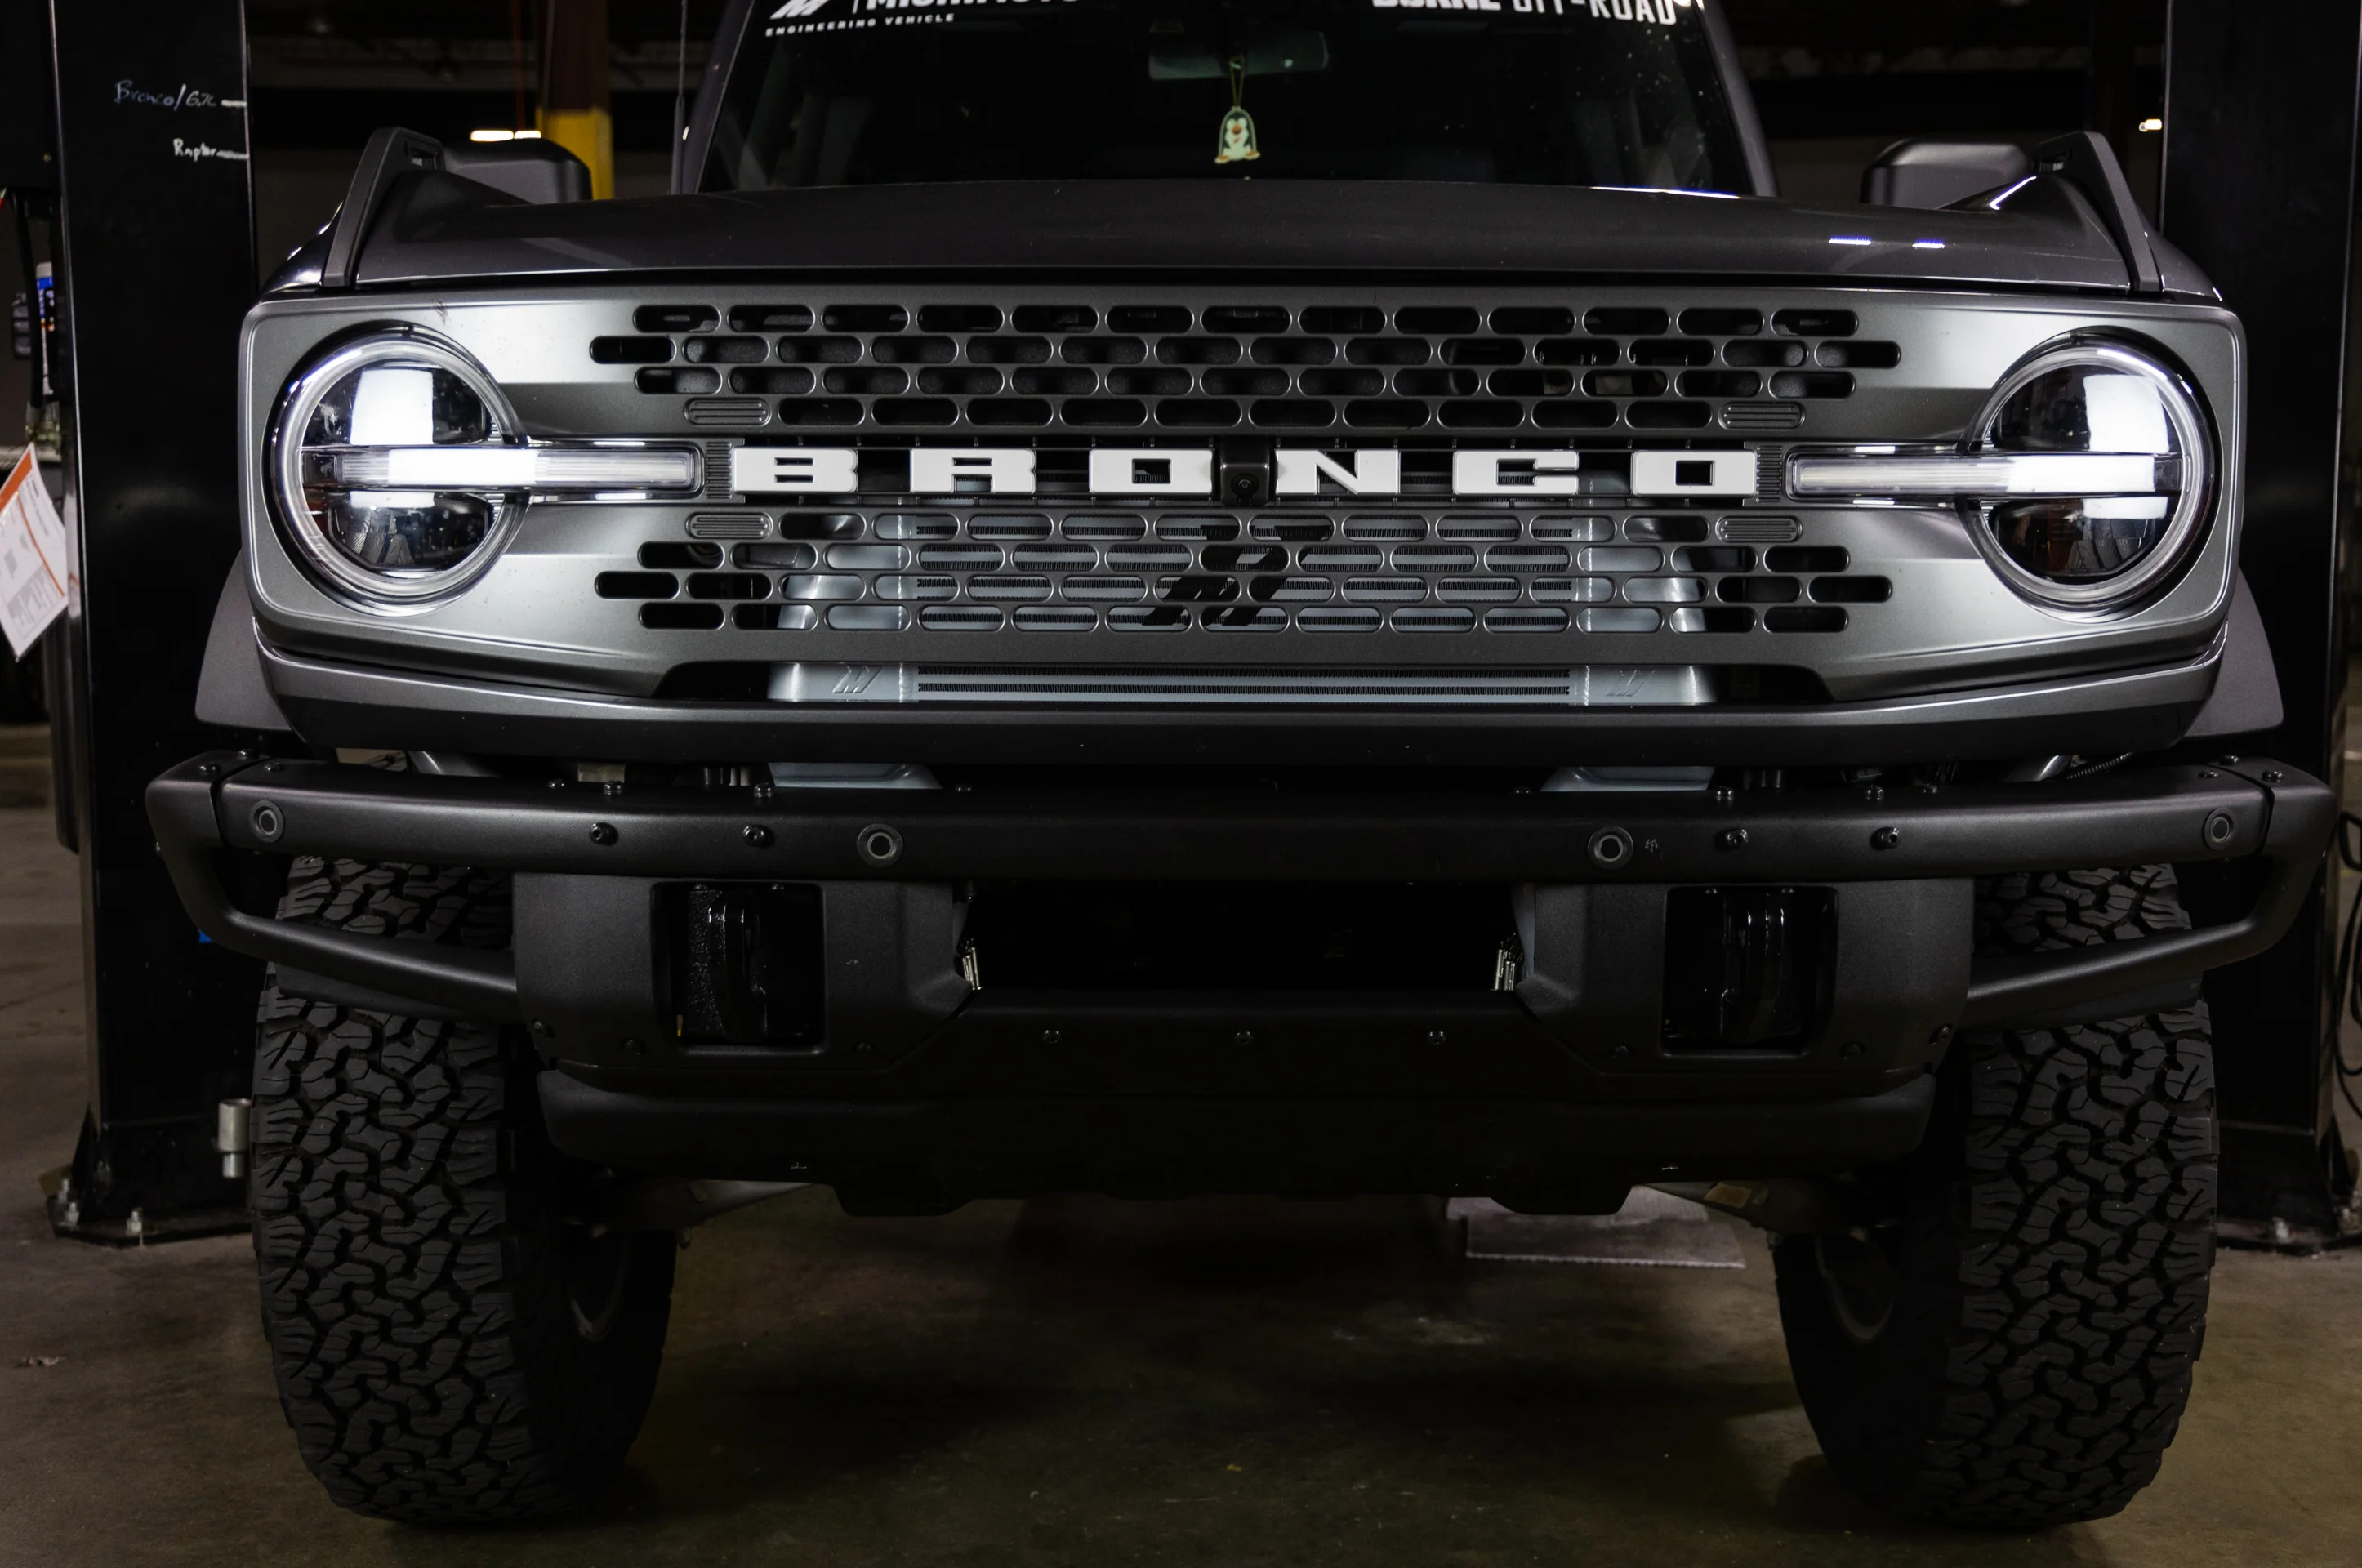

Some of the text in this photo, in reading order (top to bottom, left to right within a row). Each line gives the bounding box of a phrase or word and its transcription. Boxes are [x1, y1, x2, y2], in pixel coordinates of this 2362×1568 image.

[765, 13, 955, 37] ENGINEERING VEHICLE
[172, 137, 216, 163] Raptor
[733, 447, 1757, 495] BRONCO
